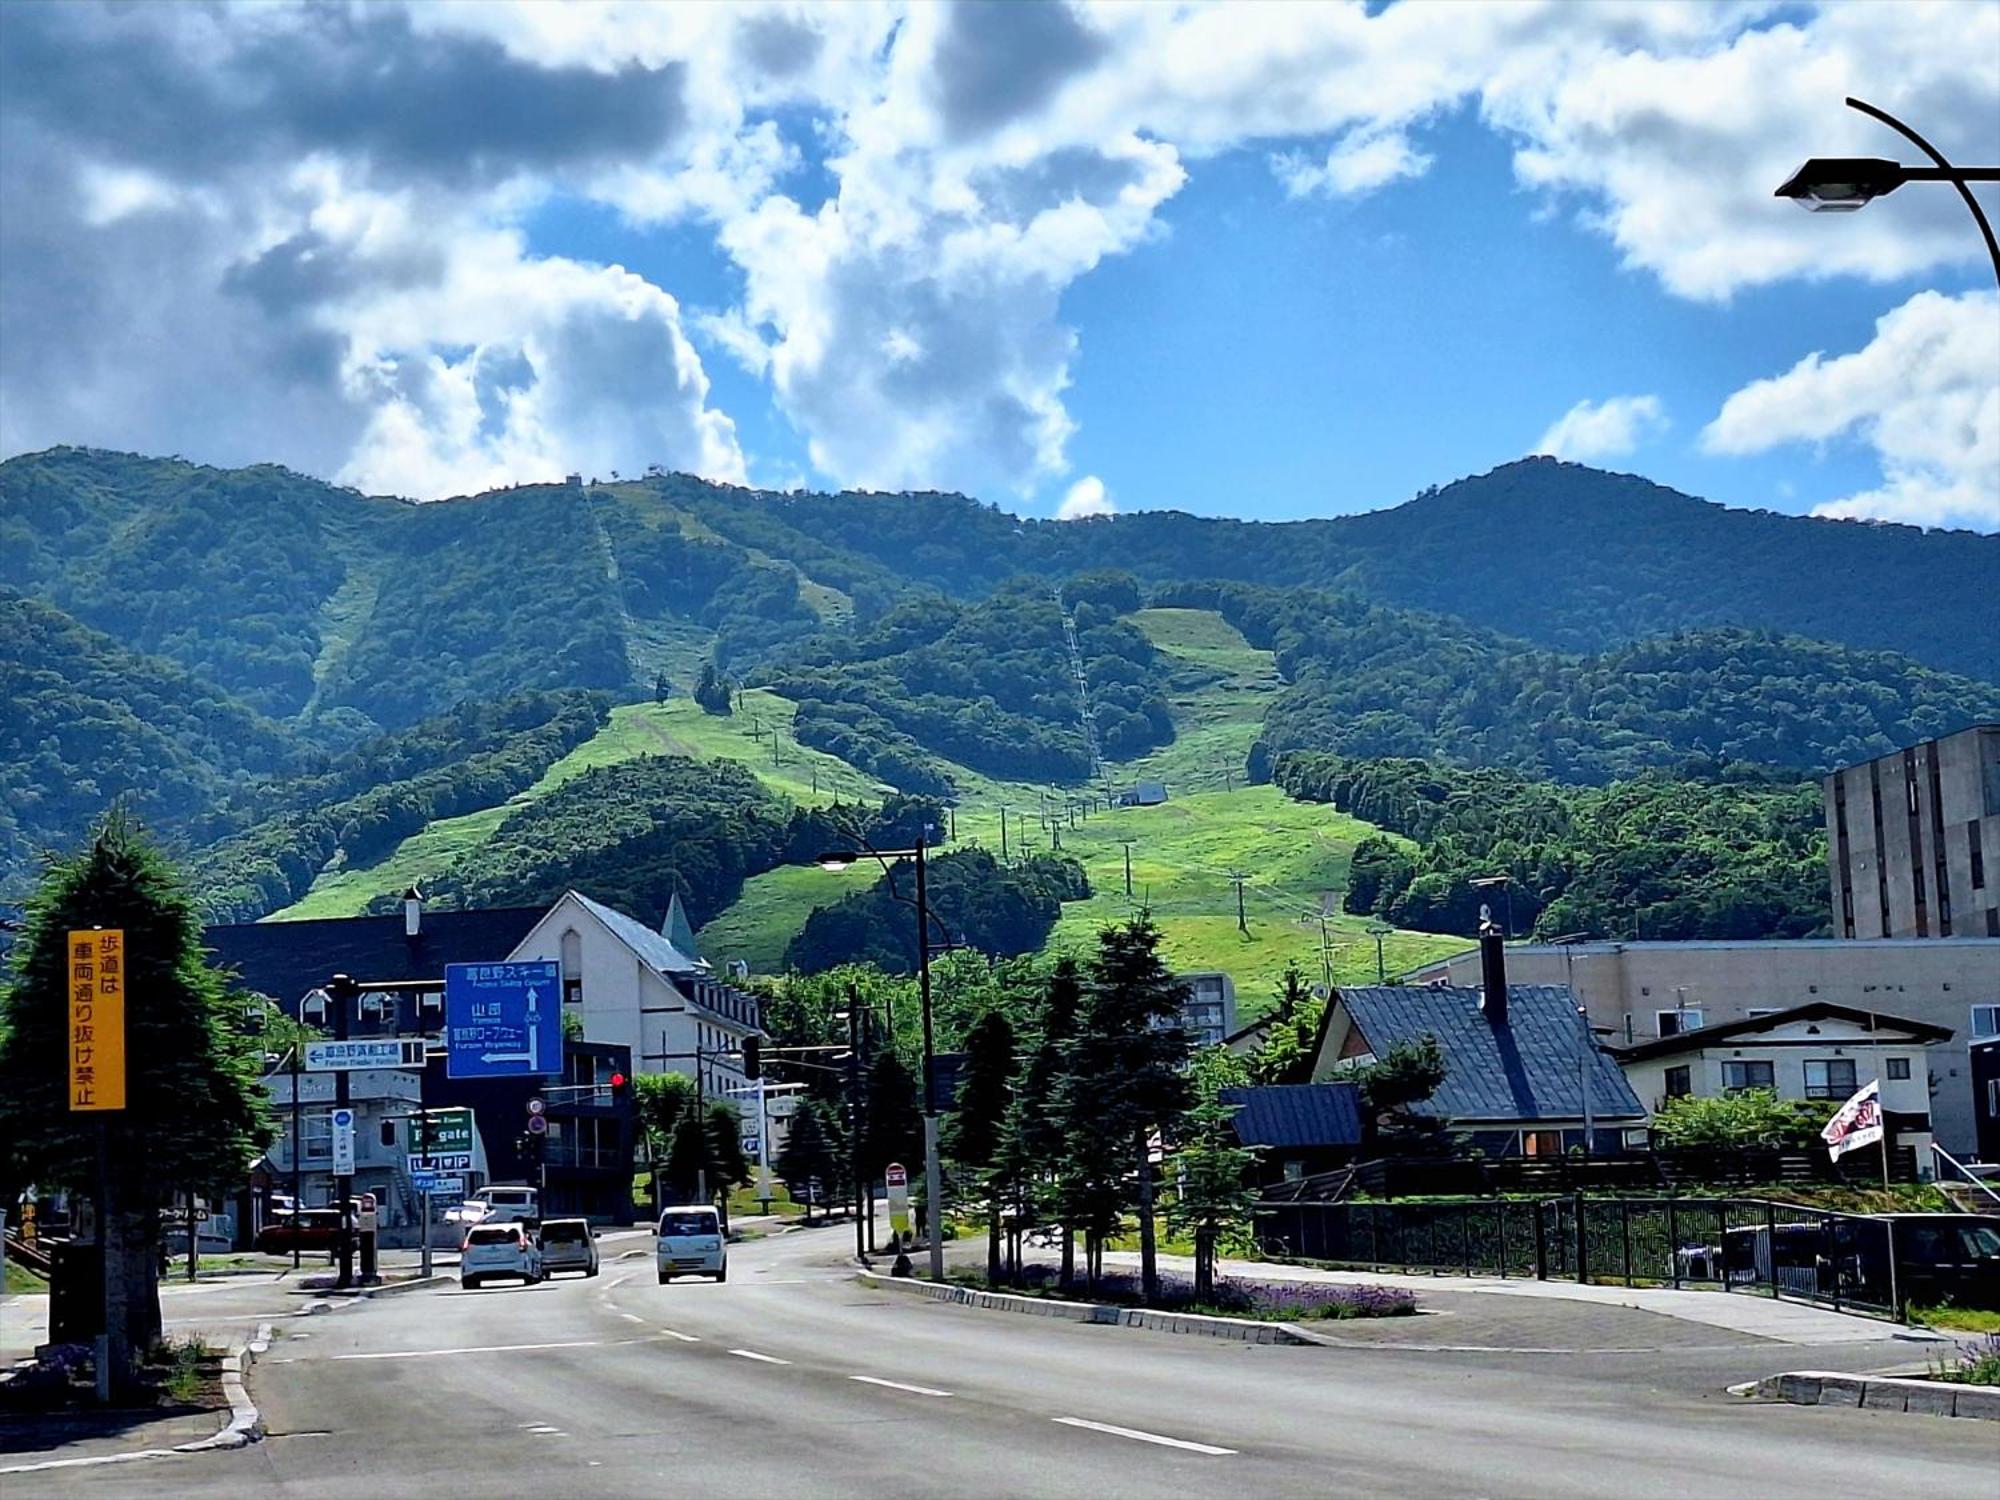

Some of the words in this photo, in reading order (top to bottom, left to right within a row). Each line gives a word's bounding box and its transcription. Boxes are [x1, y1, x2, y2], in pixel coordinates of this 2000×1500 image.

[100, 935, 119, 994] 歩道は
[73, 942, 96, 1106] 車両通り抜け禁止
